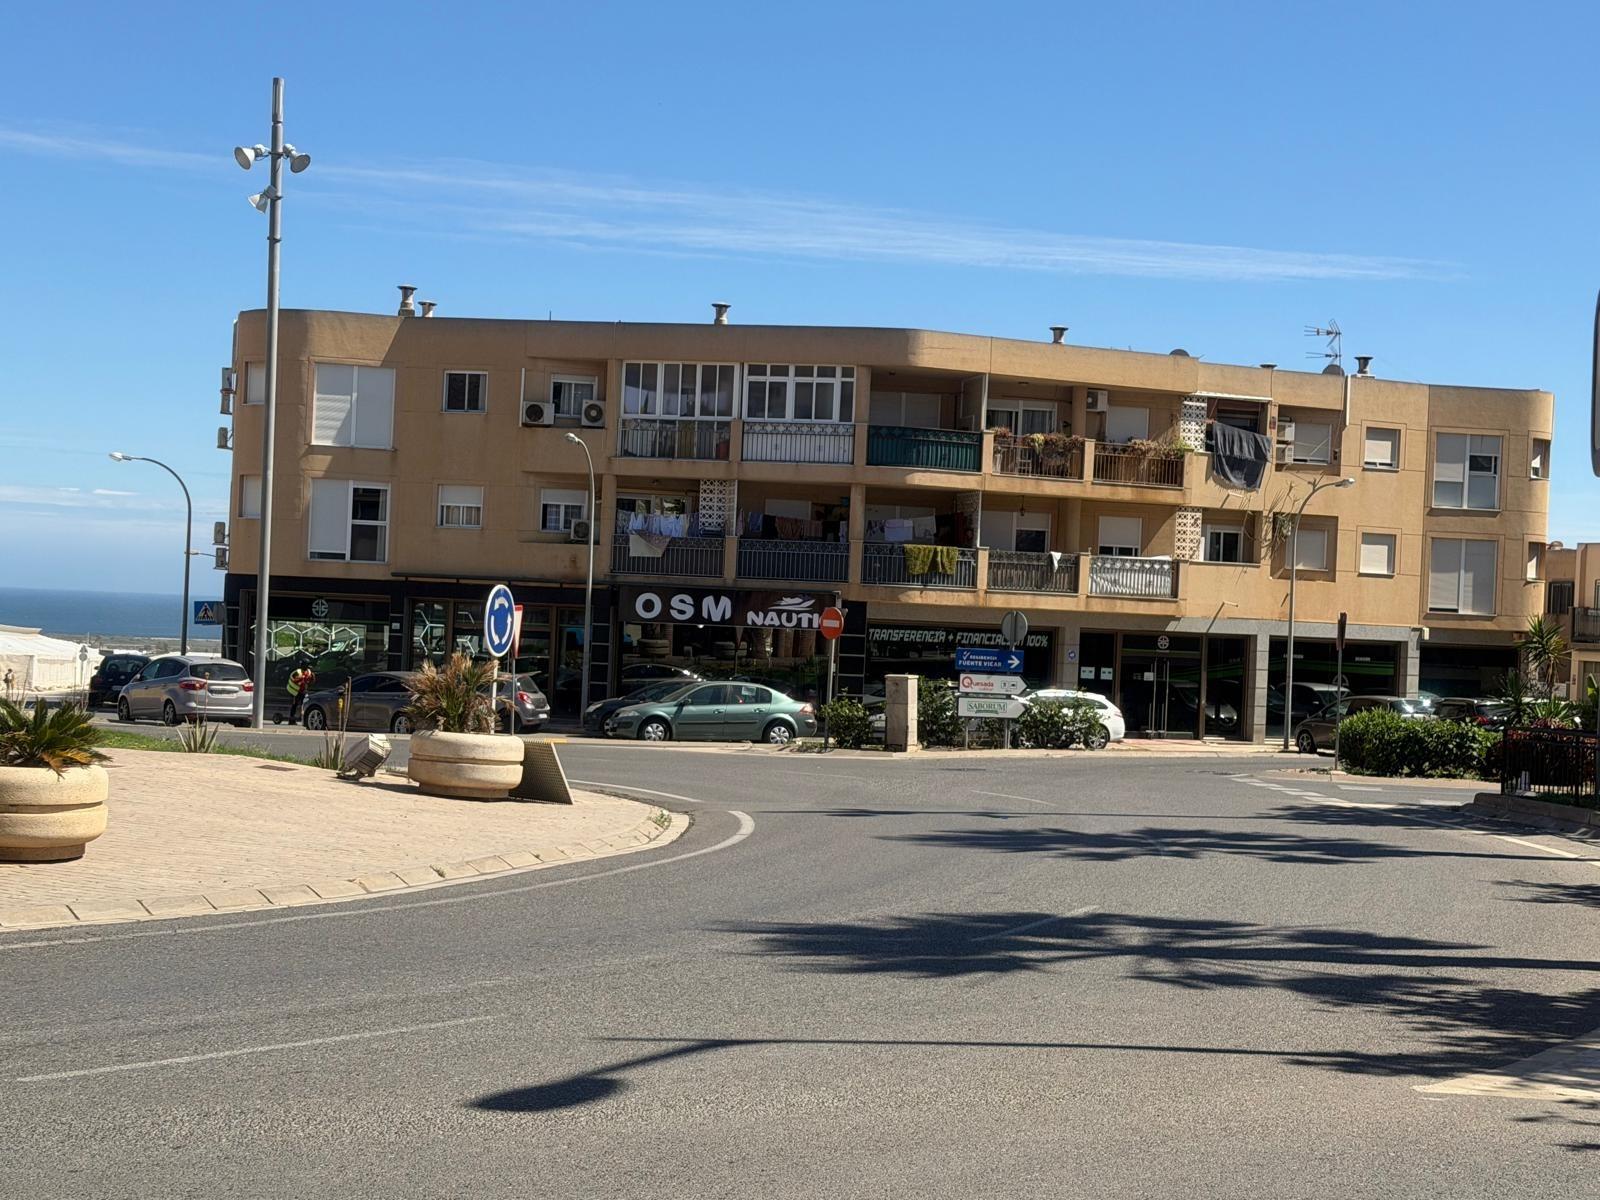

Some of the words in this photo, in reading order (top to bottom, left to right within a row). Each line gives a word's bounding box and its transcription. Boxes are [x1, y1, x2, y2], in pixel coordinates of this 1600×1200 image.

[746, 610, 820, 628] NAUTI
[1026, 634, 1049, 647] 100%
[968, 702, 1006, 711] SABORUM
